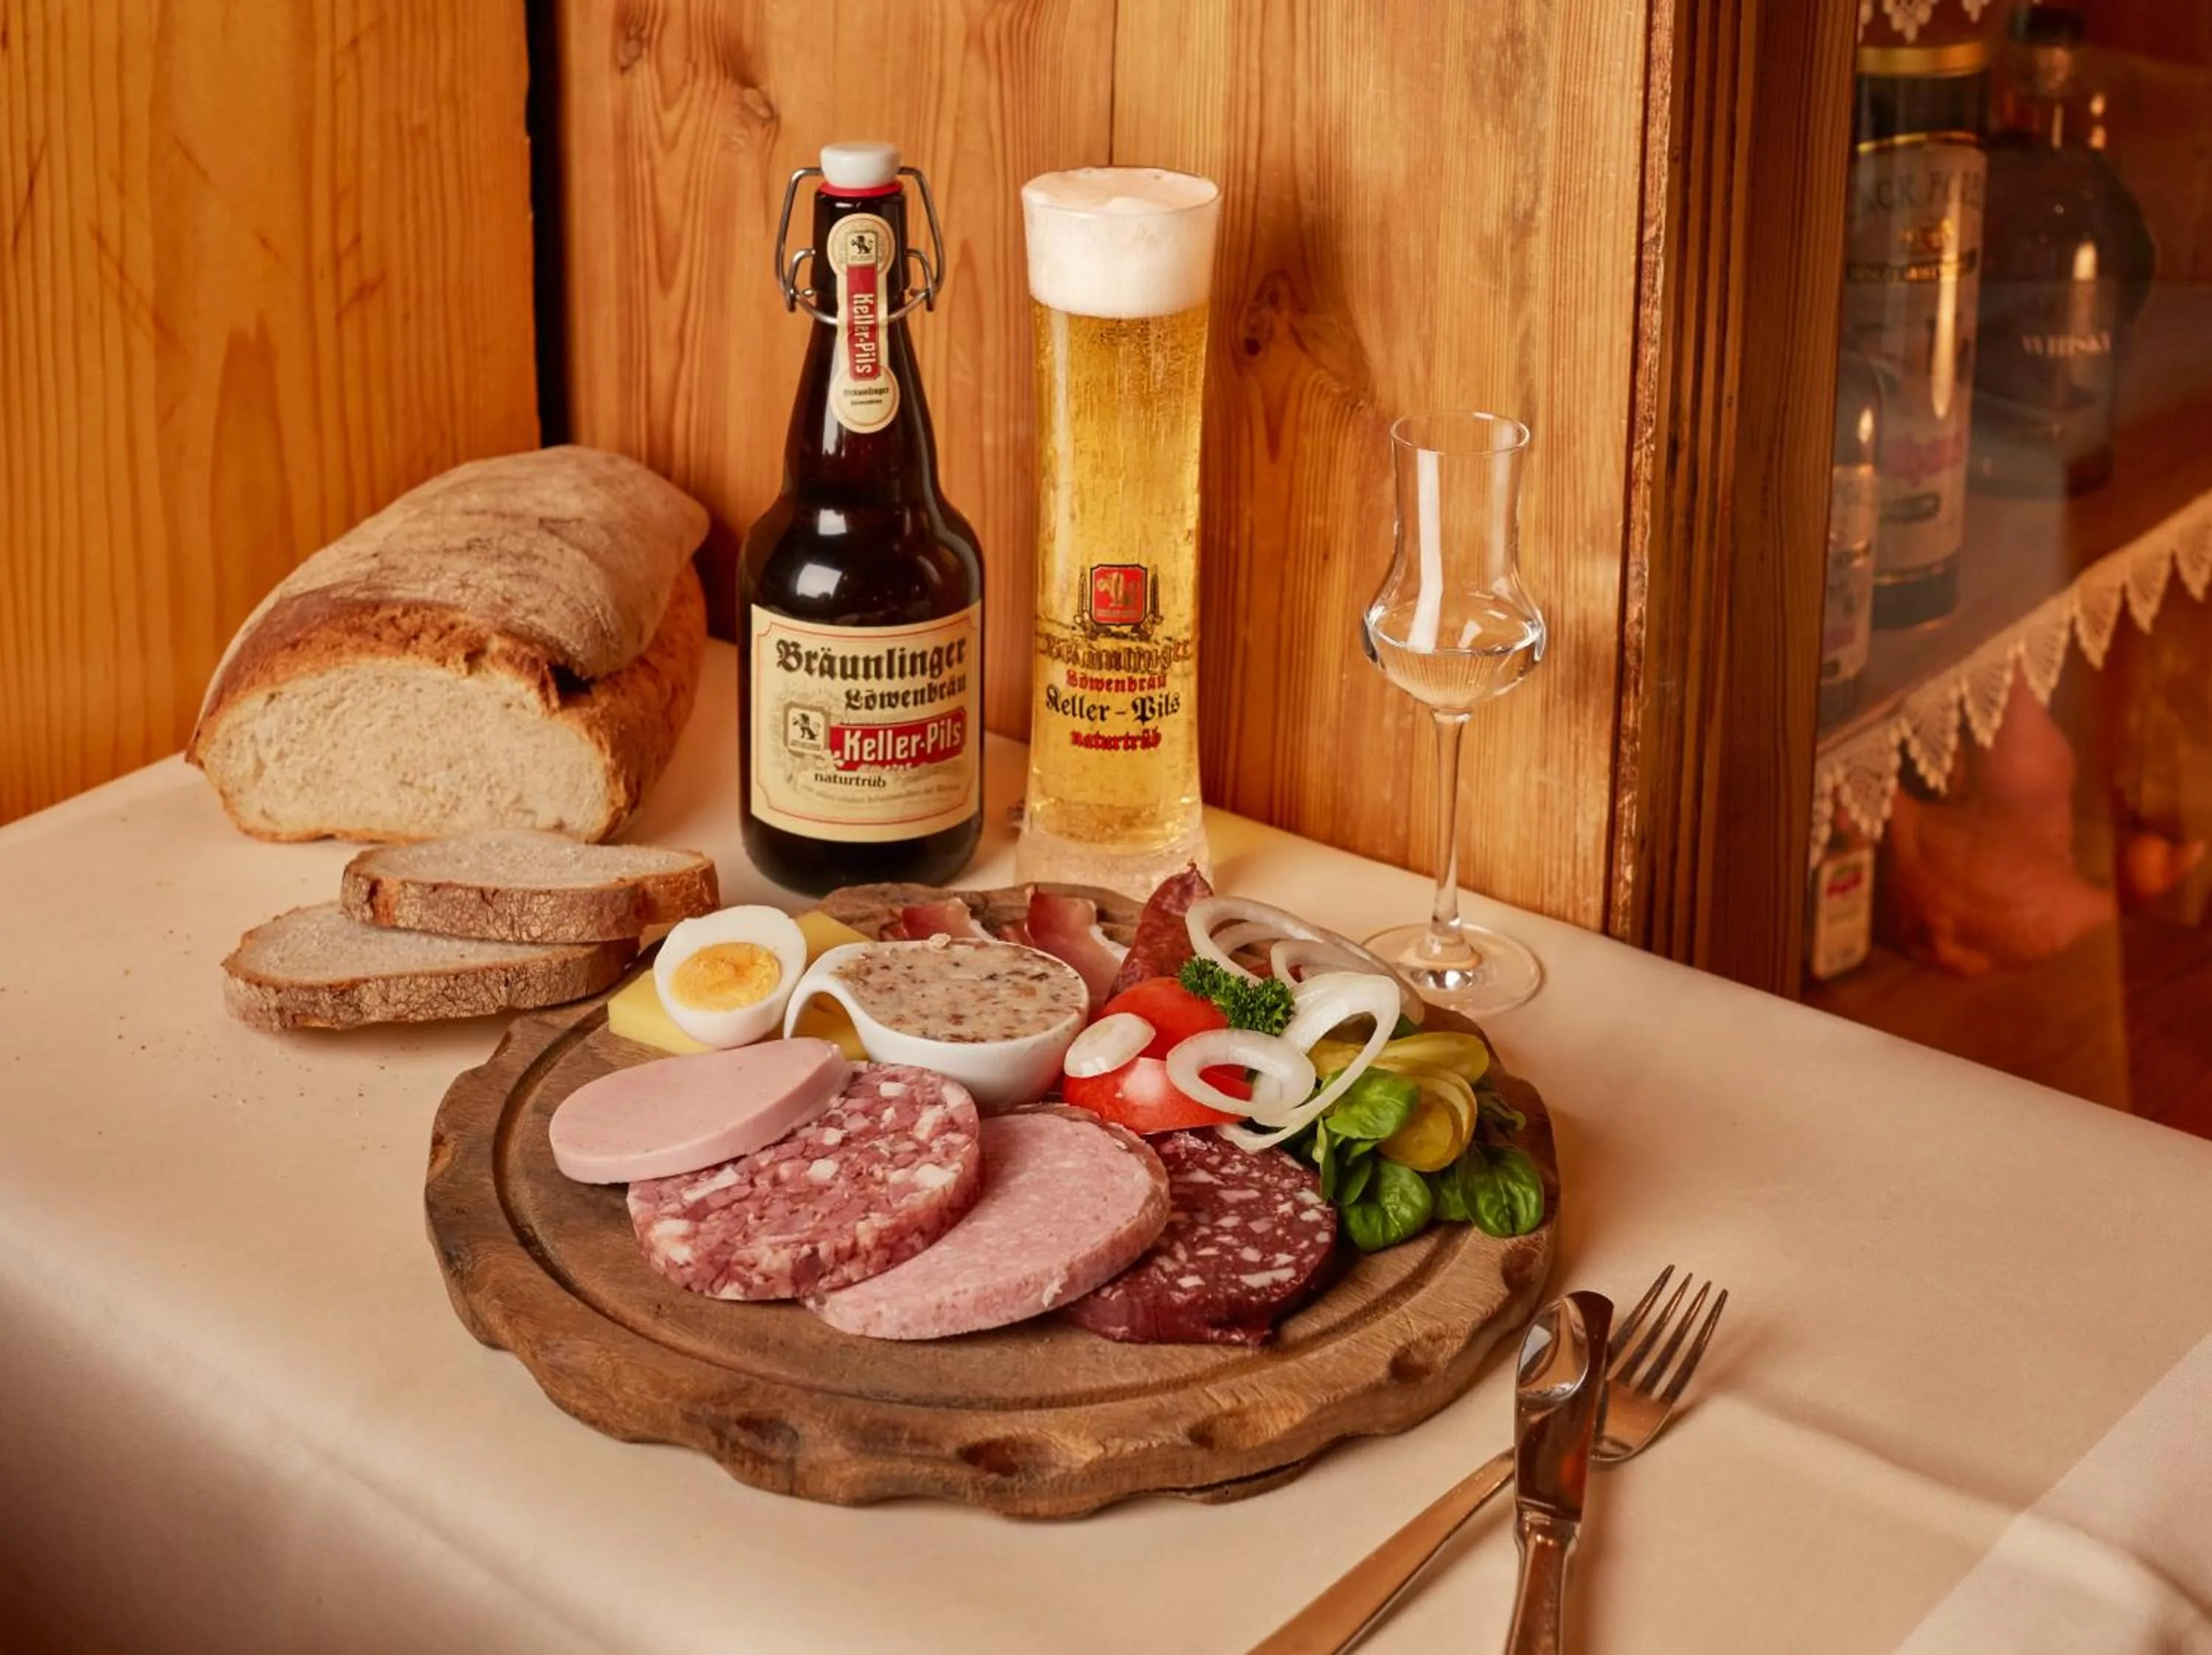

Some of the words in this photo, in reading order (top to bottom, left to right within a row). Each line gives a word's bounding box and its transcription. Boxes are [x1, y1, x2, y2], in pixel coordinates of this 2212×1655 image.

[853, 293, 877, 375] Keller-Pils
[776, 637, 967, 681] Bräunlinger
[844, 674, 967, 711] Löwenbräu
[844, 718, 962, 763] Keller-Pils
[814, 771, 886, 788] naturtrüb
